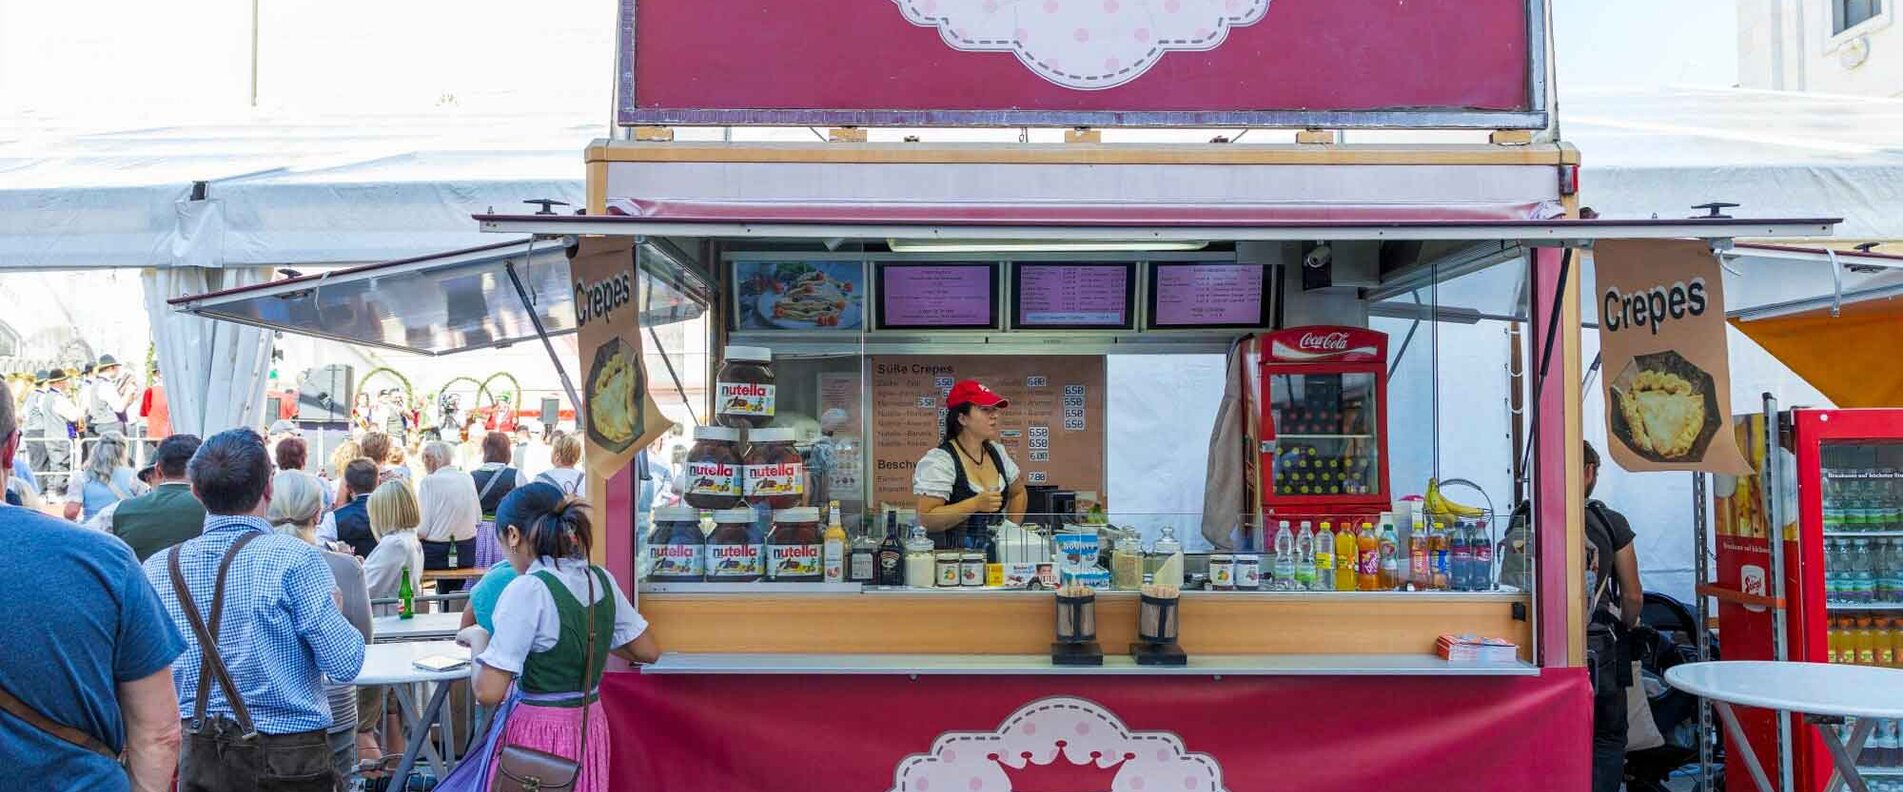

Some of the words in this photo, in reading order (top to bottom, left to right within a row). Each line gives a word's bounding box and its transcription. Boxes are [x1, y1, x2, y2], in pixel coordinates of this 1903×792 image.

[575, 274, 630, 327] Crepes
[1604, 280, 1706, 335] Crepes
[1299, 332, 1350, 349] Coca-Cola
[721, 379, 767, 397] nutella
[689, 462, 733, 477] nutella
[750, 463, 794, 478] nutella
[650, 545, 693, 558] nutella
[713, 544, 757, 558] nutella
[773, 544, 818, 558] nutella
